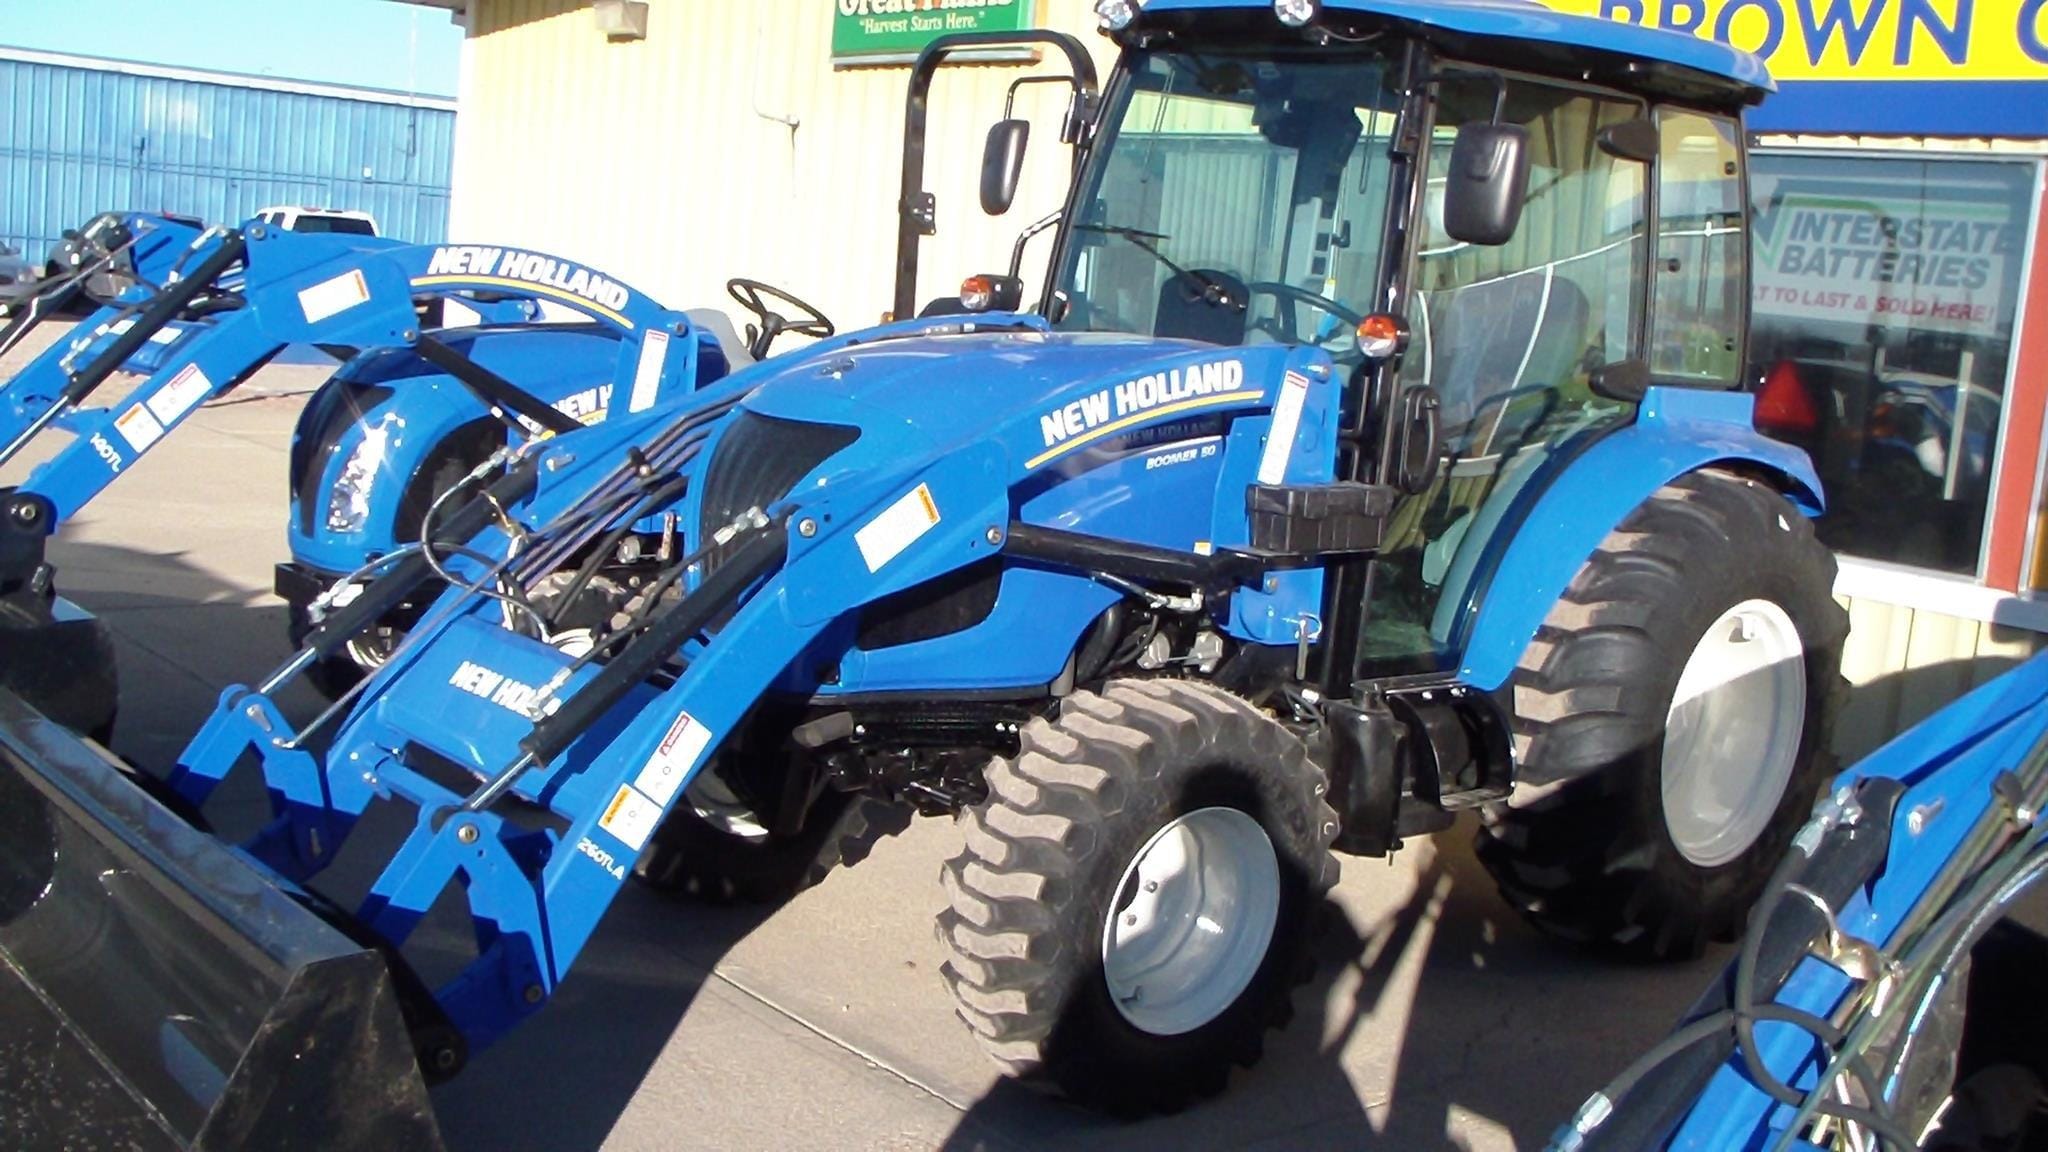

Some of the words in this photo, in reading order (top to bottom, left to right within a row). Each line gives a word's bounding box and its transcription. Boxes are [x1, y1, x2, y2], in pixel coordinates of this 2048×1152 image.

[911, 15, 943, 32] Starts
[1788, 211, 2018, 254] INTERSTATE
[427, 247, 502, 275] NEW
[498, 250, 629, 311] HOLLAND
[1778, 245, 1991, 290] BATTERIES
[1775, 287, 1799, 303] TO
[1802, 290, 1851, 308] LAST
[1854, 295, 1867, 310] &
[1877, 297, 1926, 315] SOLD
[1040, 389, 1110, 447] NEW
[1114, 359, 1243, 417] HOLLAND
[90, 432, 122, 472] 140TL
[1146, 449, 1198, 470] BOOMER
[1201, 445, 1216, 458] 50
[449, 661, 504, 698] NEW
